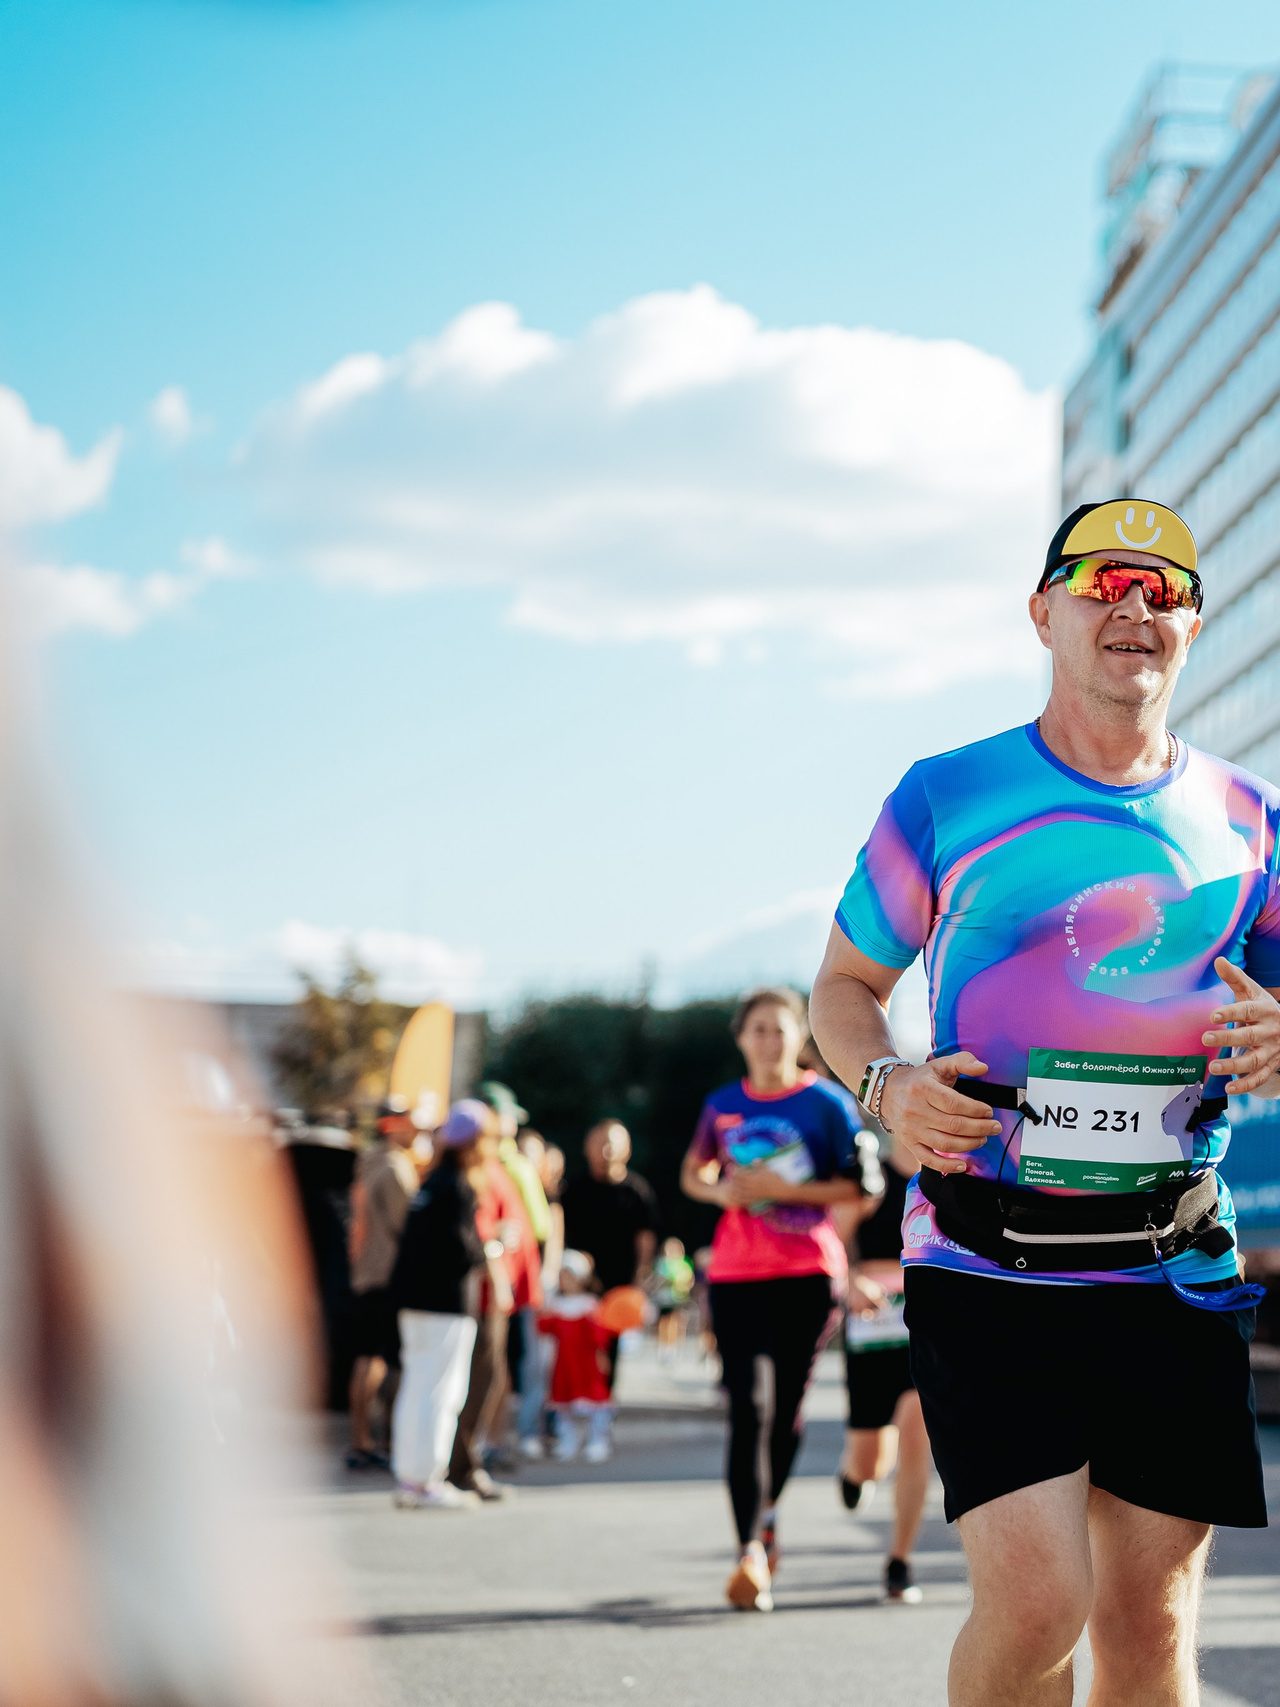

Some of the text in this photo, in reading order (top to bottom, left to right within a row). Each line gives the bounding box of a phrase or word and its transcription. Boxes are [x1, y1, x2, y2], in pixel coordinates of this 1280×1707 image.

[1065, 880, 1165, 977] ЧЕЛЯБИНСКИЙ МАРАФОН 2025
[1054, 1060, 1196, 1075] Забег волонтёров Южного Урала
[1043, 1104, 1140, 1133] № 231
[1026, 1160, 1044, 1168] Беги.
[908, 1232, 943, 1246] Оптик
[1173, 1283, 1206, 1301] MALIDAK
